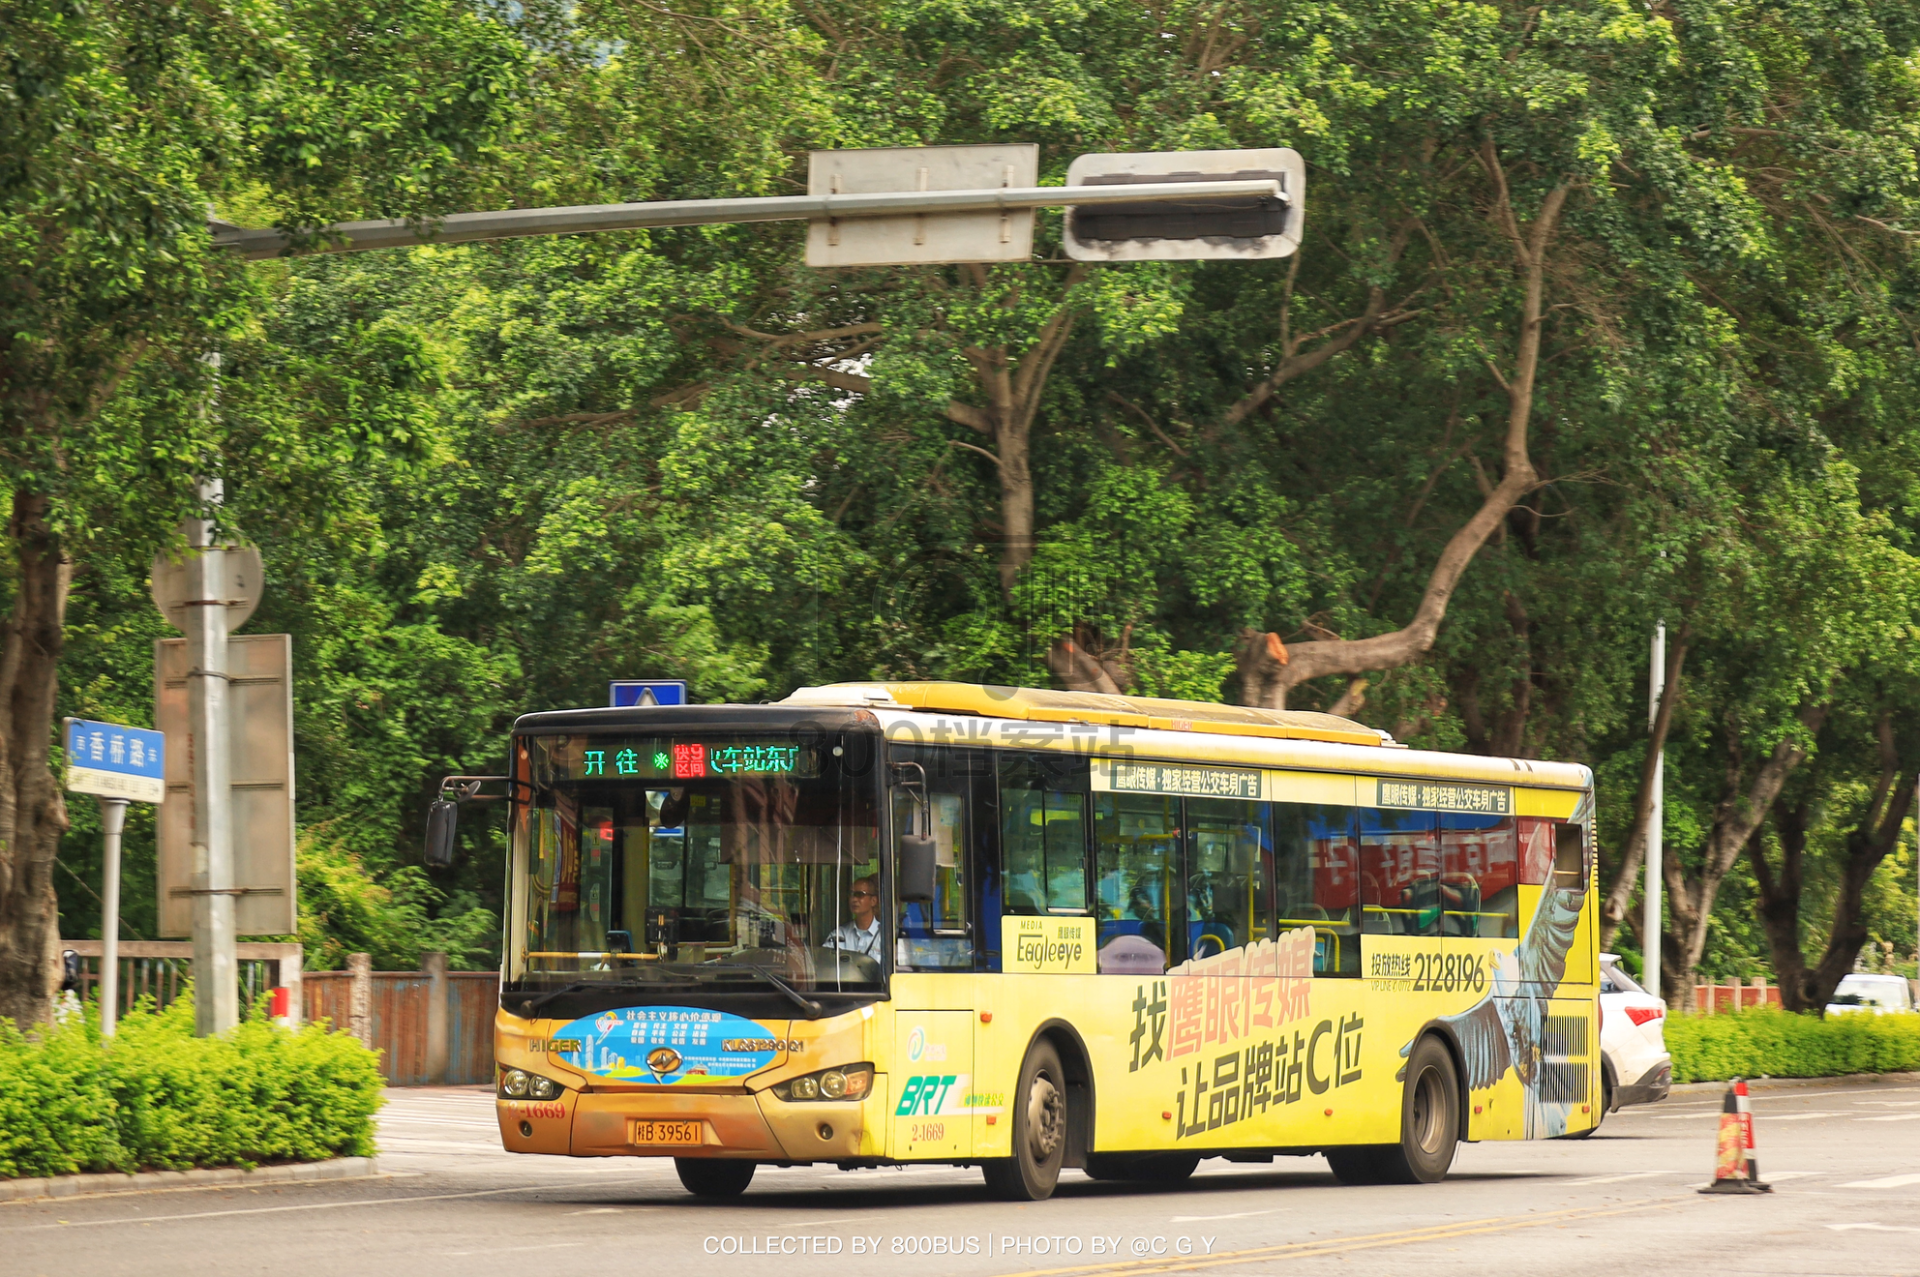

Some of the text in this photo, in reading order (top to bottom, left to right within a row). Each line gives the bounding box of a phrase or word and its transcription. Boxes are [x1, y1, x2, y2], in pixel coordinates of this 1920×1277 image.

[1020, 920, 1043, 930] MEDIA
[1371, 952, 1485, 993] 投放热线 2128196
[529, 1039, 582, 1053] HIGER
[895, 1075, 957, 1116] BRT
[1175, 1010, 1364, 1142] 让品牌站C位
